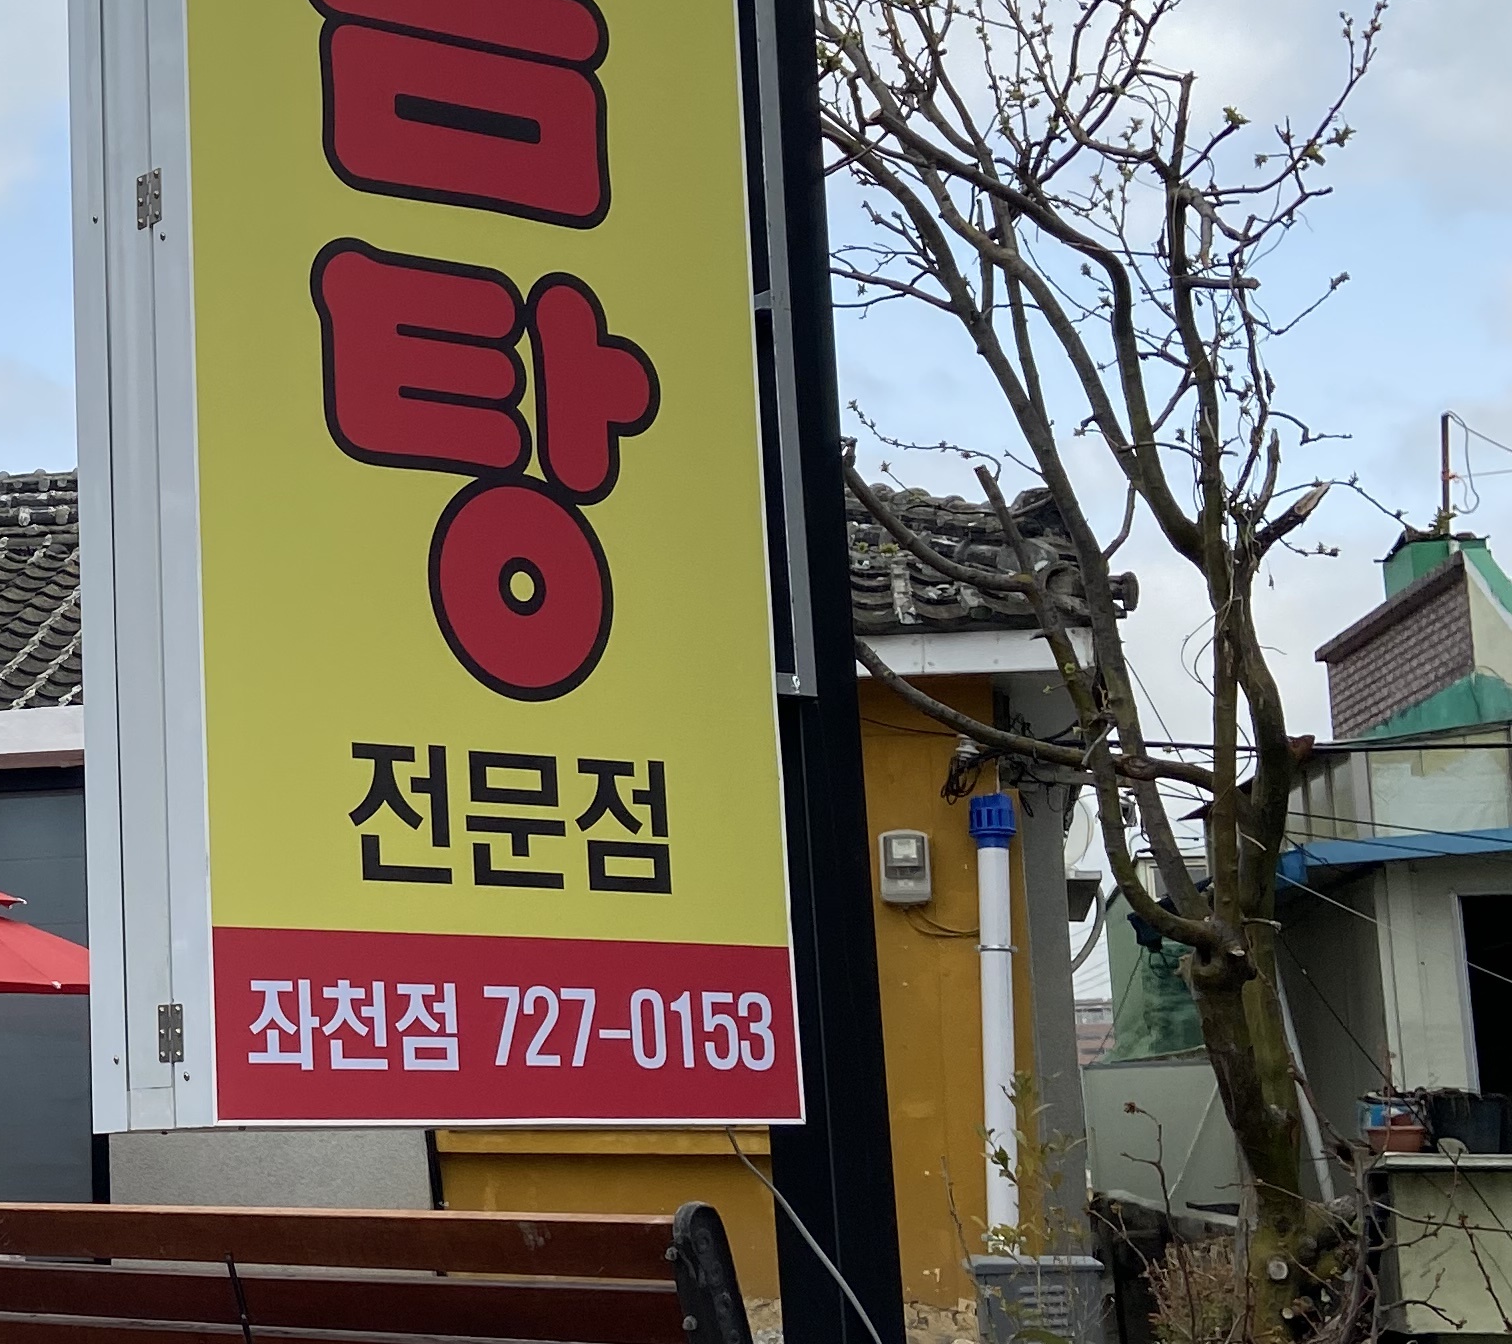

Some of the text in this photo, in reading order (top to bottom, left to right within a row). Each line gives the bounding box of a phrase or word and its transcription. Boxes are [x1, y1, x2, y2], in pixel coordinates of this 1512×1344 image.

[349, 742, 672, 895] 전문점
[247, 979, 776, 1073] 좌천점 727-0153
